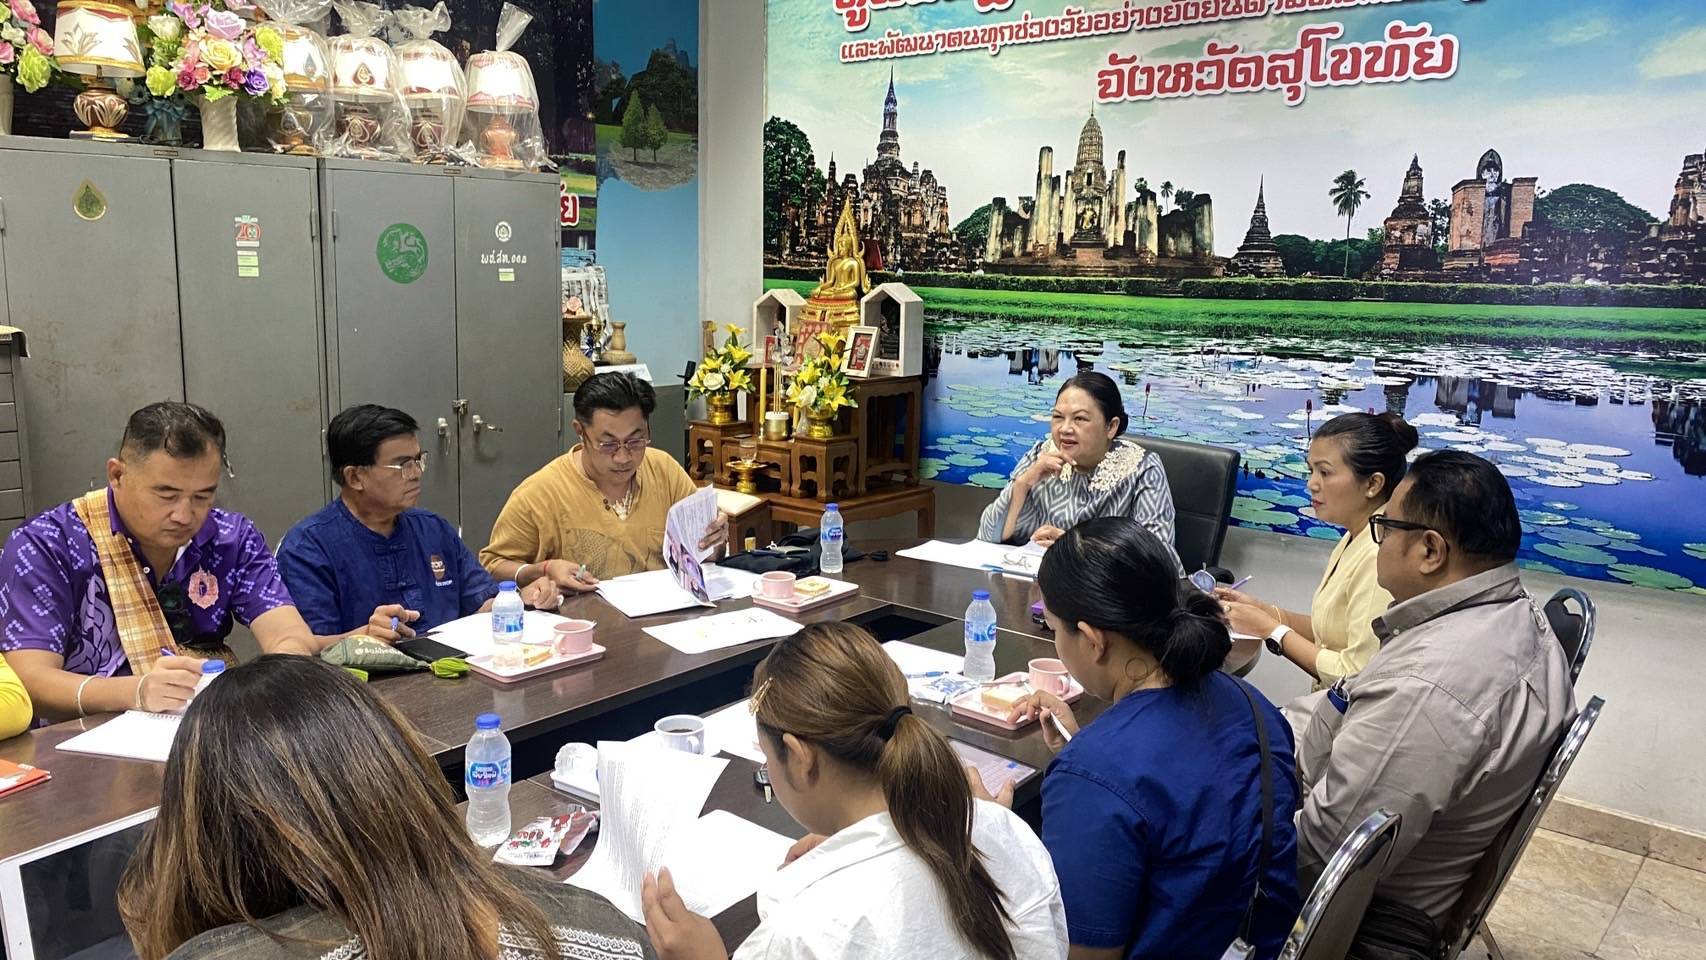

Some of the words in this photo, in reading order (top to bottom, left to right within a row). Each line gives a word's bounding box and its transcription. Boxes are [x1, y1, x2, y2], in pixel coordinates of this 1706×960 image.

[1097, 25, 1455, 102] จังหวัดสุโขทัย
